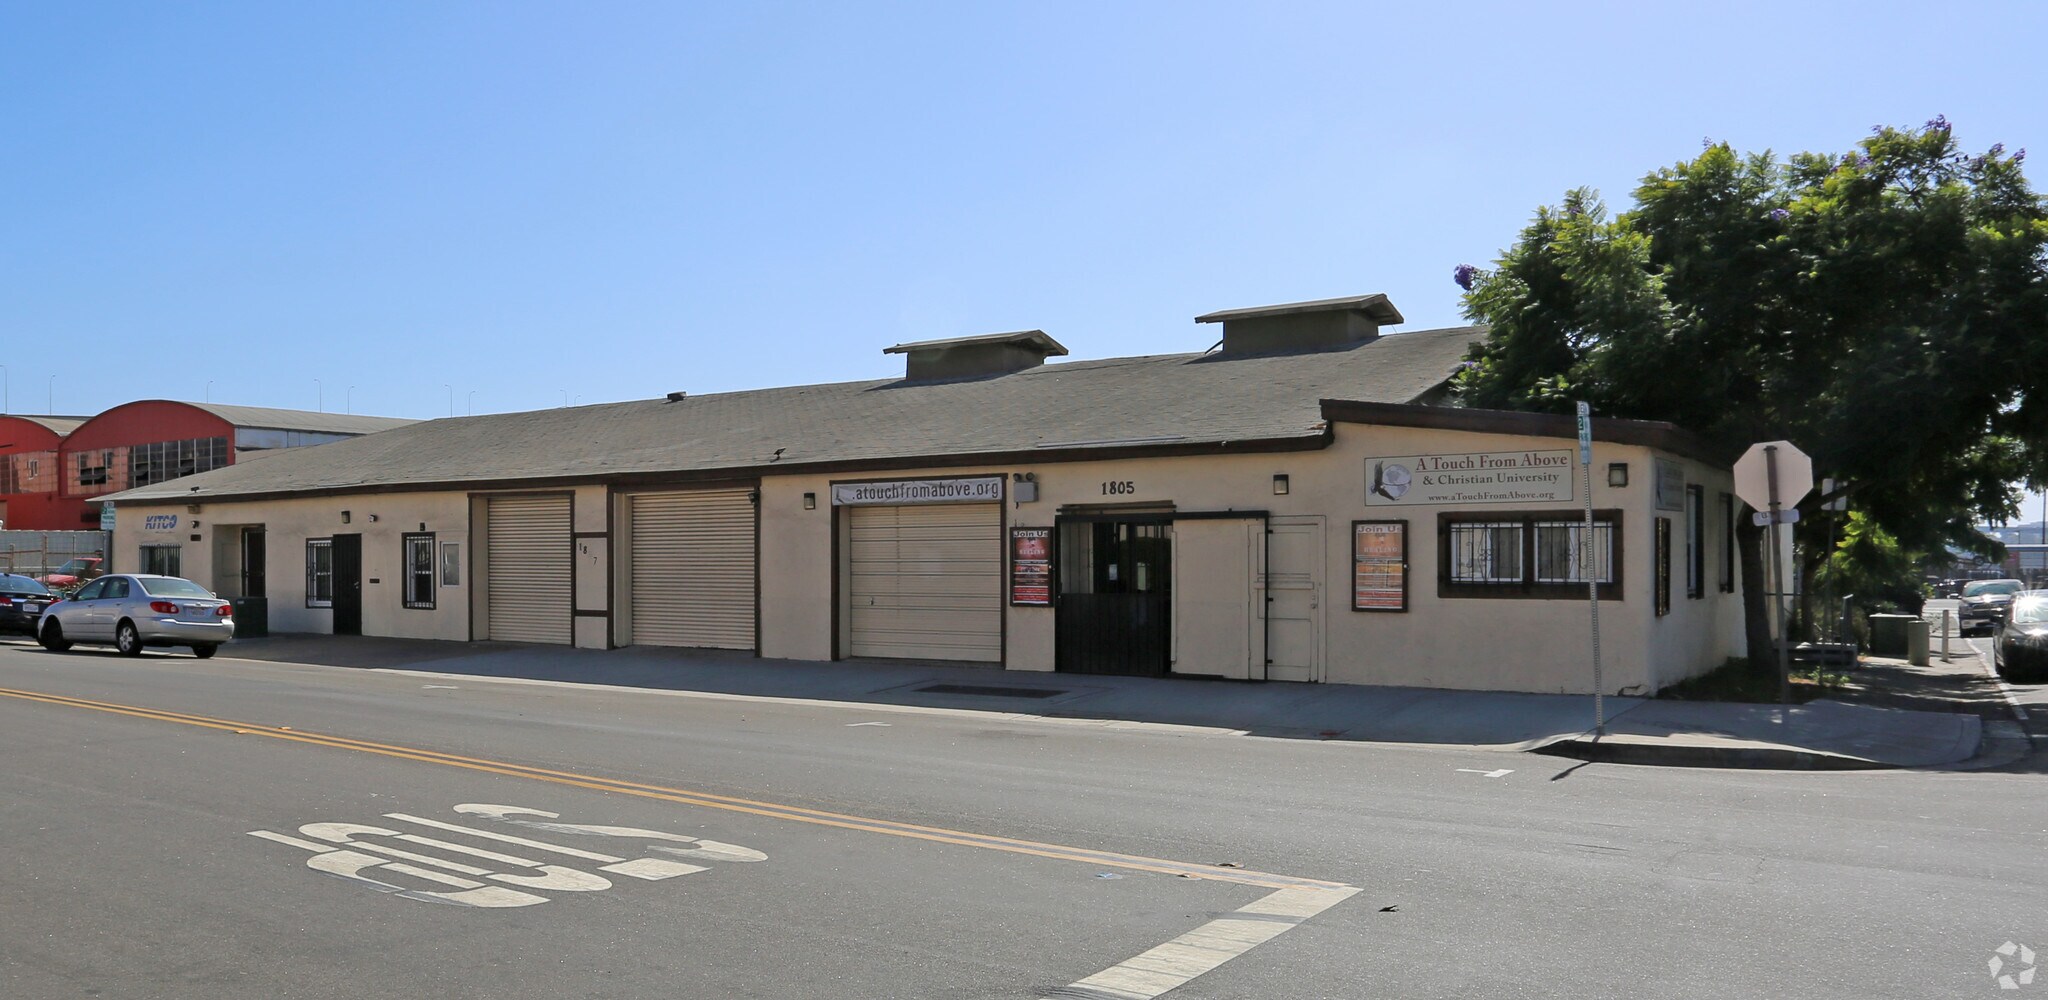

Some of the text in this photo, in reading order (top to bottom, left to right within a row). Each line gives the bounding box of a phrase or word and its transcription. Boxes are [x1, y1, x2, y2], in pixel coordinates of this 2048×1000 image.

[1416, 453, 1568, 471] A Touch From Above
[1422, 472, 1560, 485] & Christian University
[1101, 481, 1135, 495] 1805
[1428, 491, 1555, 502] www.aTouchFromAbove.org
[145, 515, 177, 530] KITCO
[1358, 525, 1383, 533] Join
[245, 803, 768, 909] STOP
